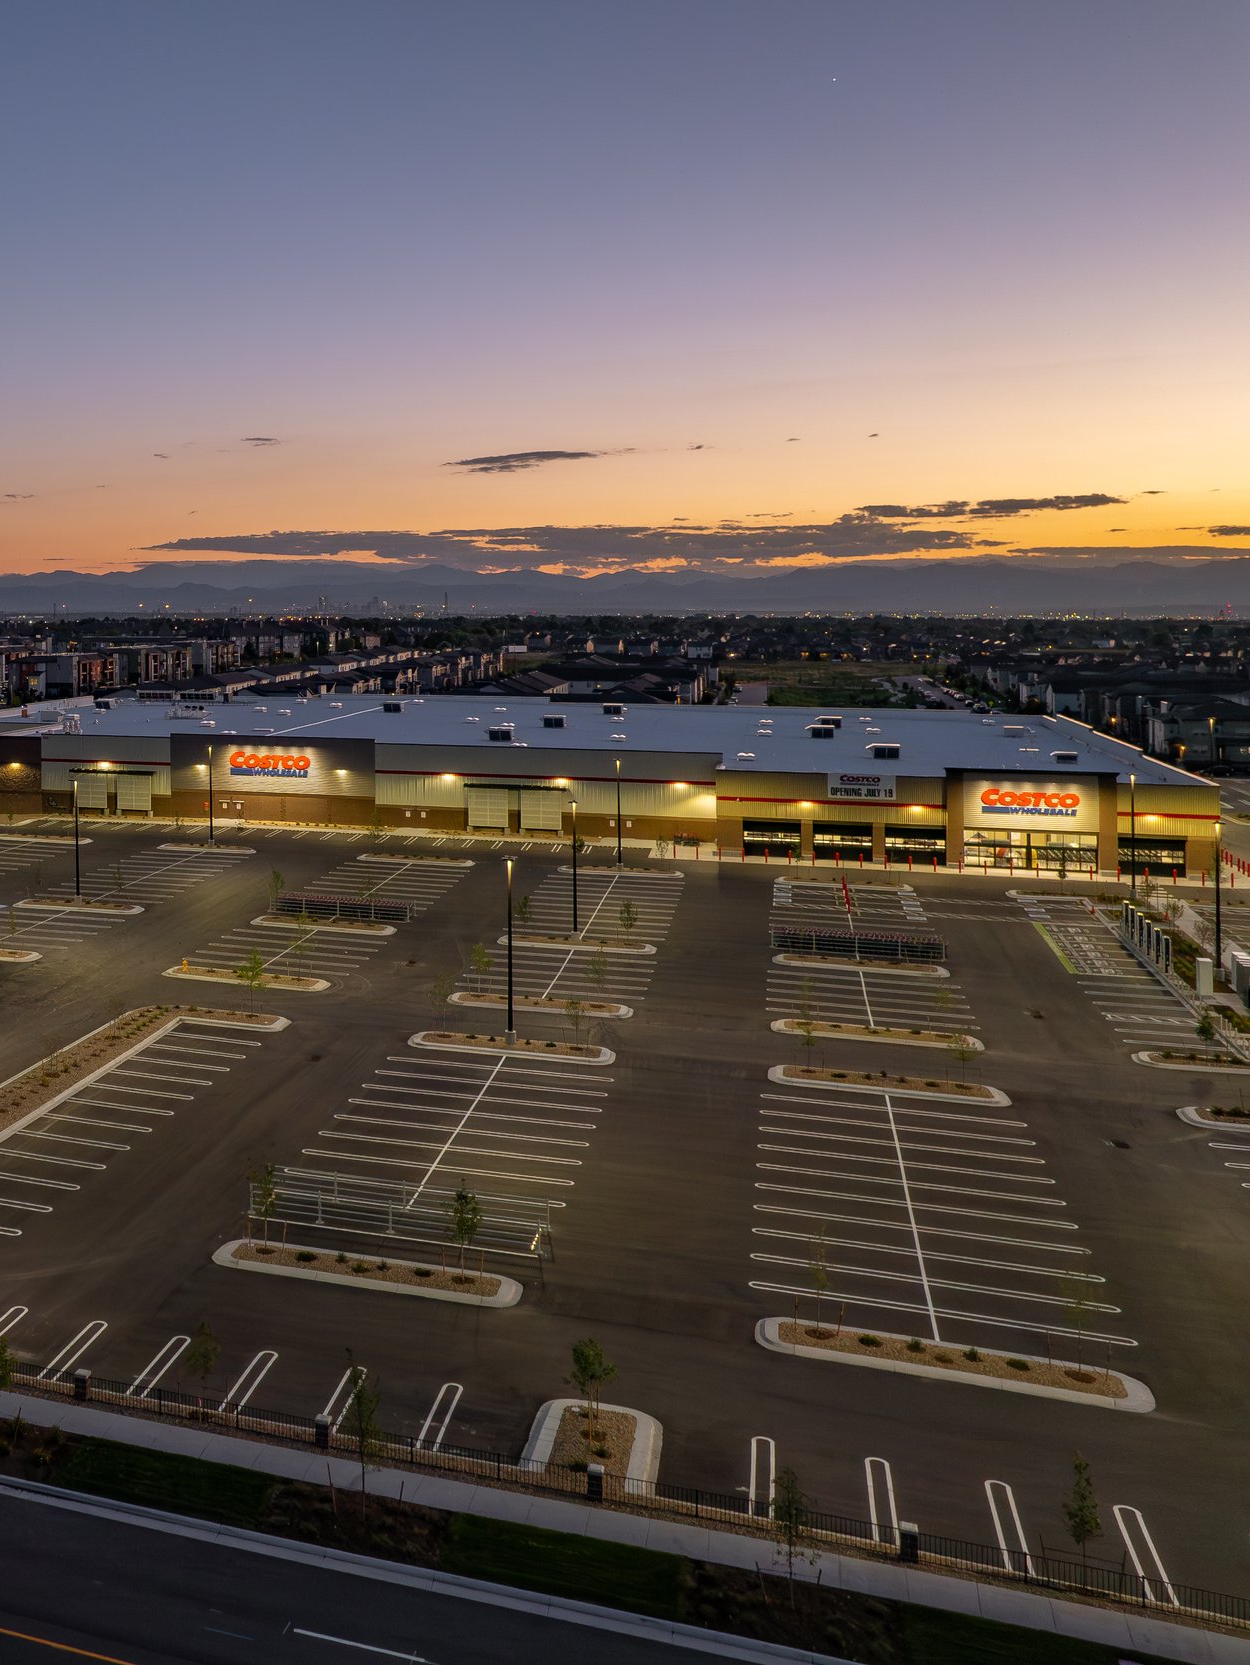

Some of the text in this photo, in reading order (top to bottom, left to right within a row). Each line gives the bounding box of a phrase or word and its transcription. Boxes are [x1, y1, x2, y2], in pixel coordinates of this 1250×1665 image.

[230, 751, 310, 769] COSTCO
[253, 769, 308, 777] WHOLESALE
[840, 775, 881, 783] COSTCO
[830, 787, 863, 797] OPENING
[864, 788, 881, 798] JULY
[981, 789, 1080, 808] COSTCO
[1010, 807, 1077, 816] WHOLESALE
